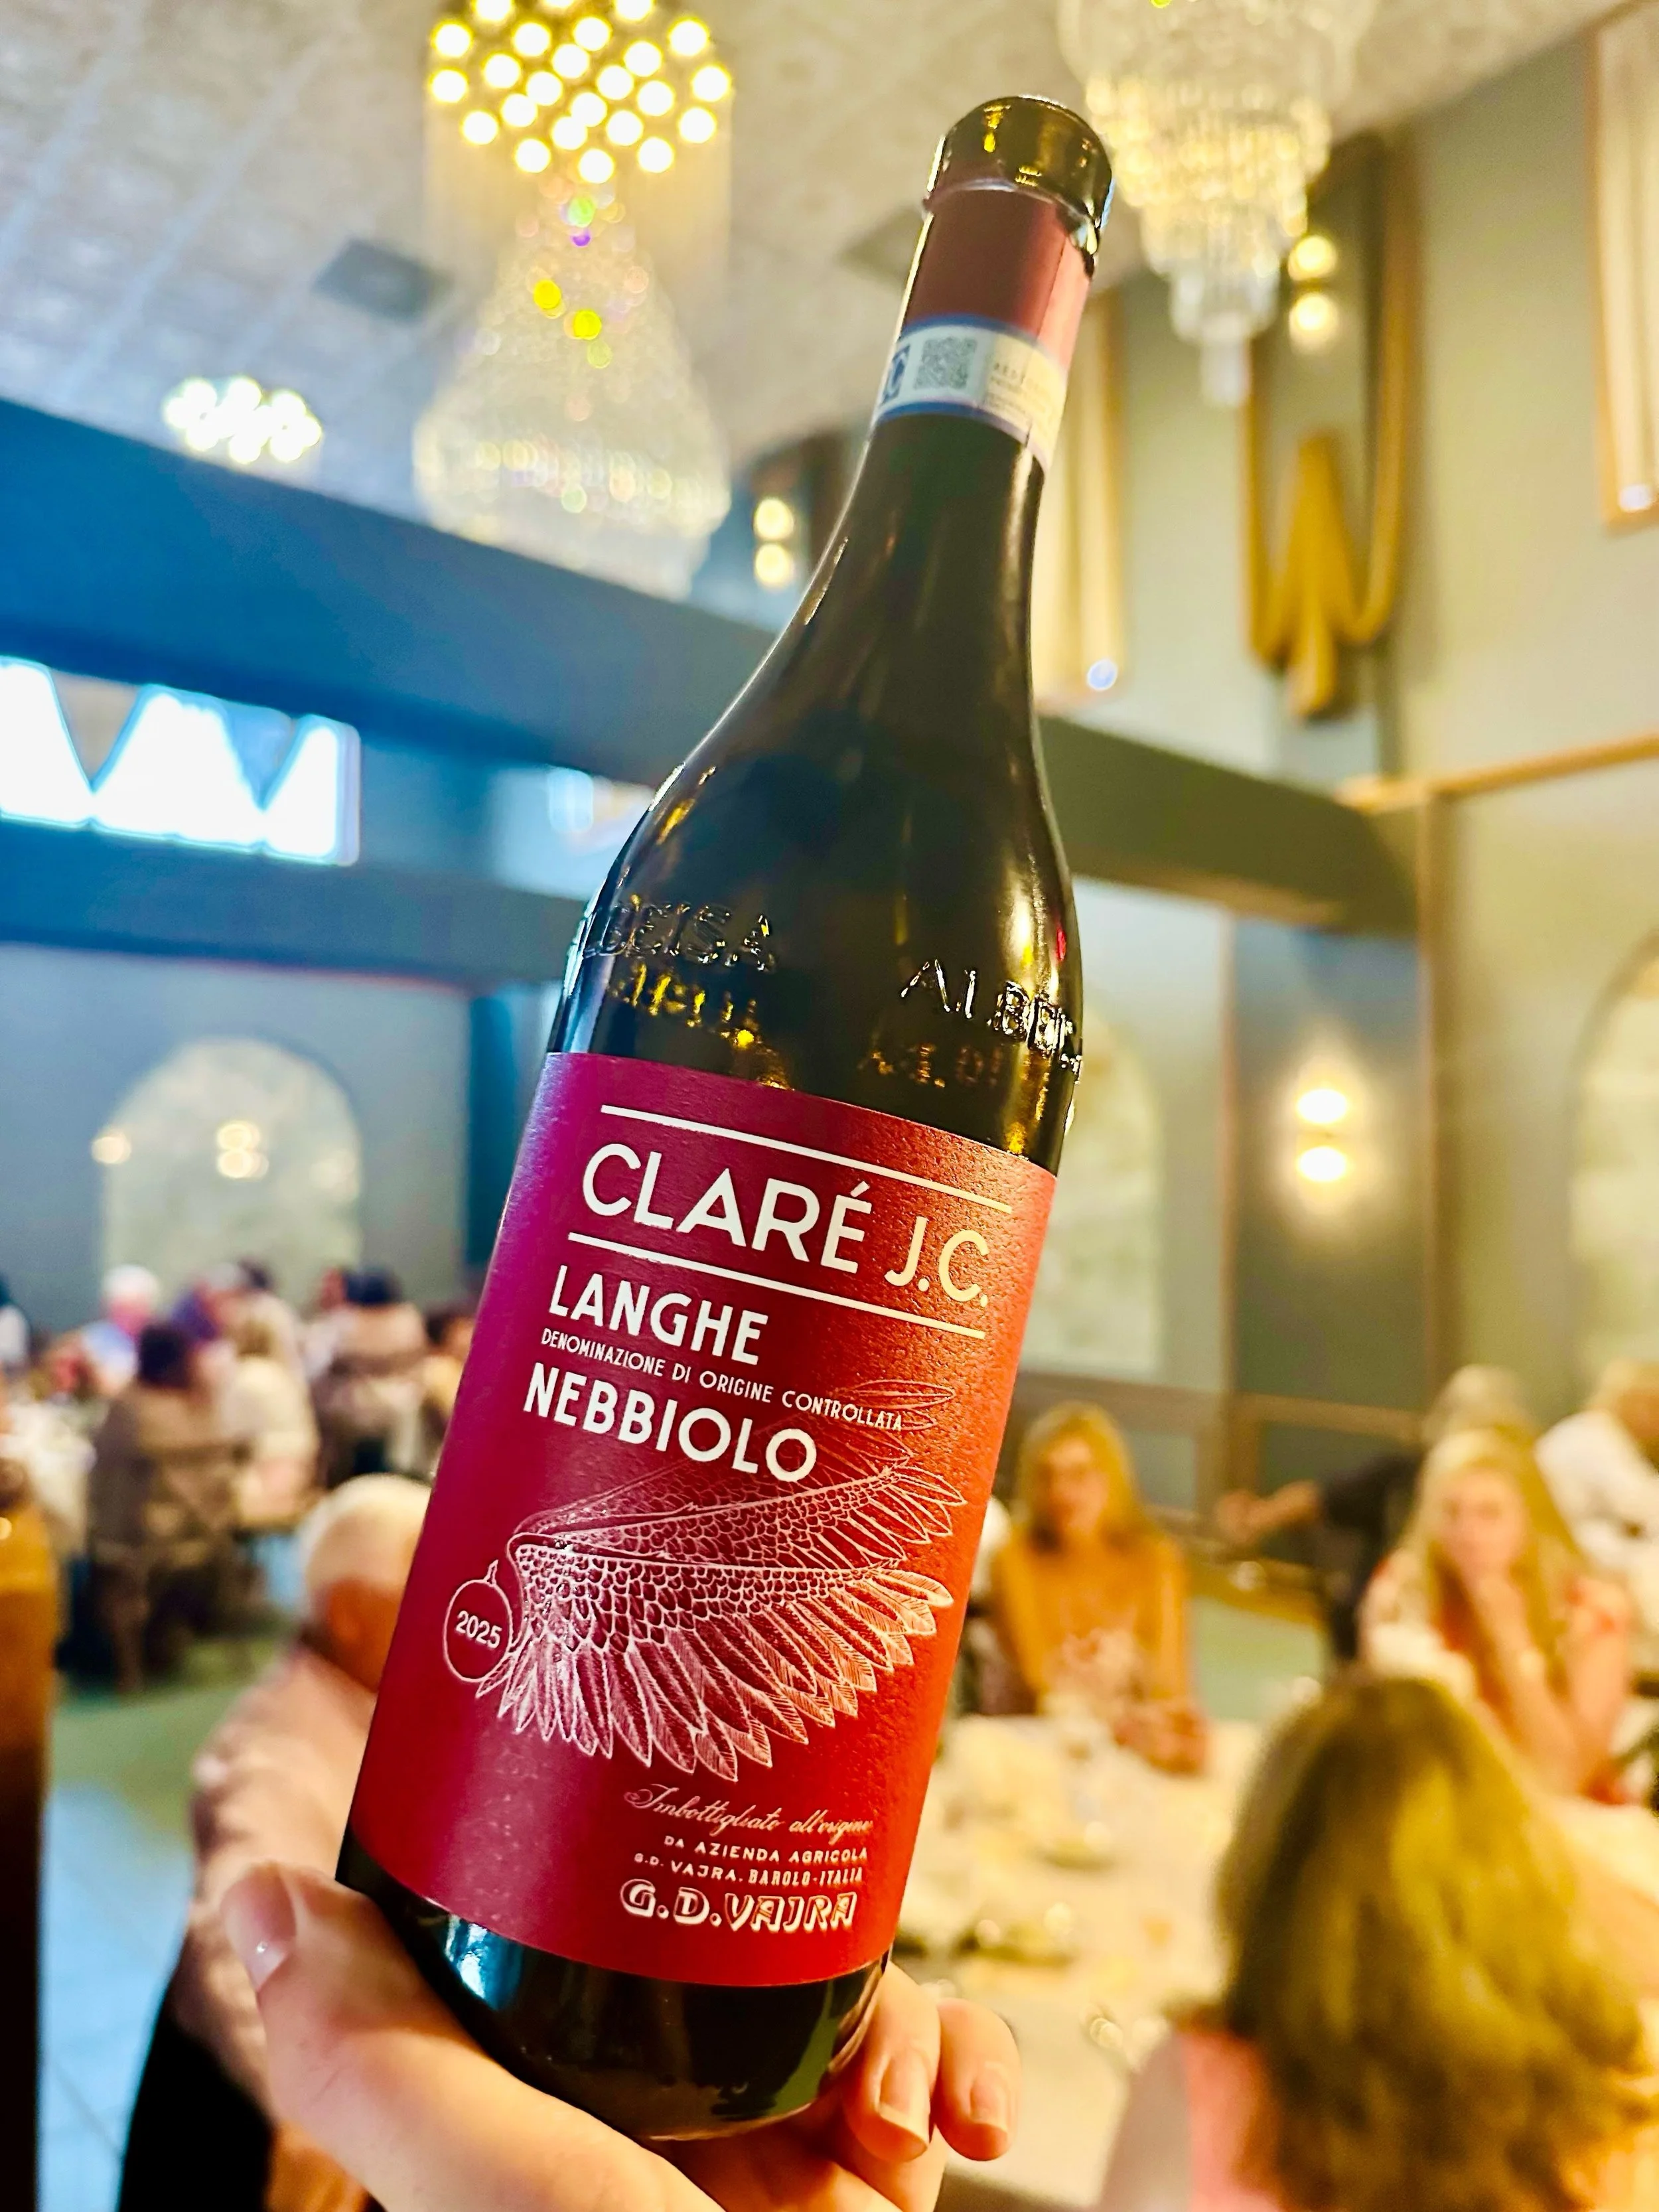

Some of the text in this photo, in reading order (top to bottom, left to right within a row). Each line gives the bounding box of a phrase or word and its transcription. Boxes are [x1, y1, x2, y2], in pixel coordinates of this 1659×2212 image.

[583, 1143, 989, 1307] CLARÉ J.C.
[549, 1264, 769, 1365] LANGHE
[522, 1362, 817, 1483] NEBBIOLO
[541, 1329, 903, 1432] DENOMINAZIONE DI ORIGINE CONTROLLATA
[456, 1610, 502, 1649] 2025
[624, 1784, 785, 1837] Imbottigliato
[664, 1835, 867, 1864] DA AZIENDA AGRICOLA
